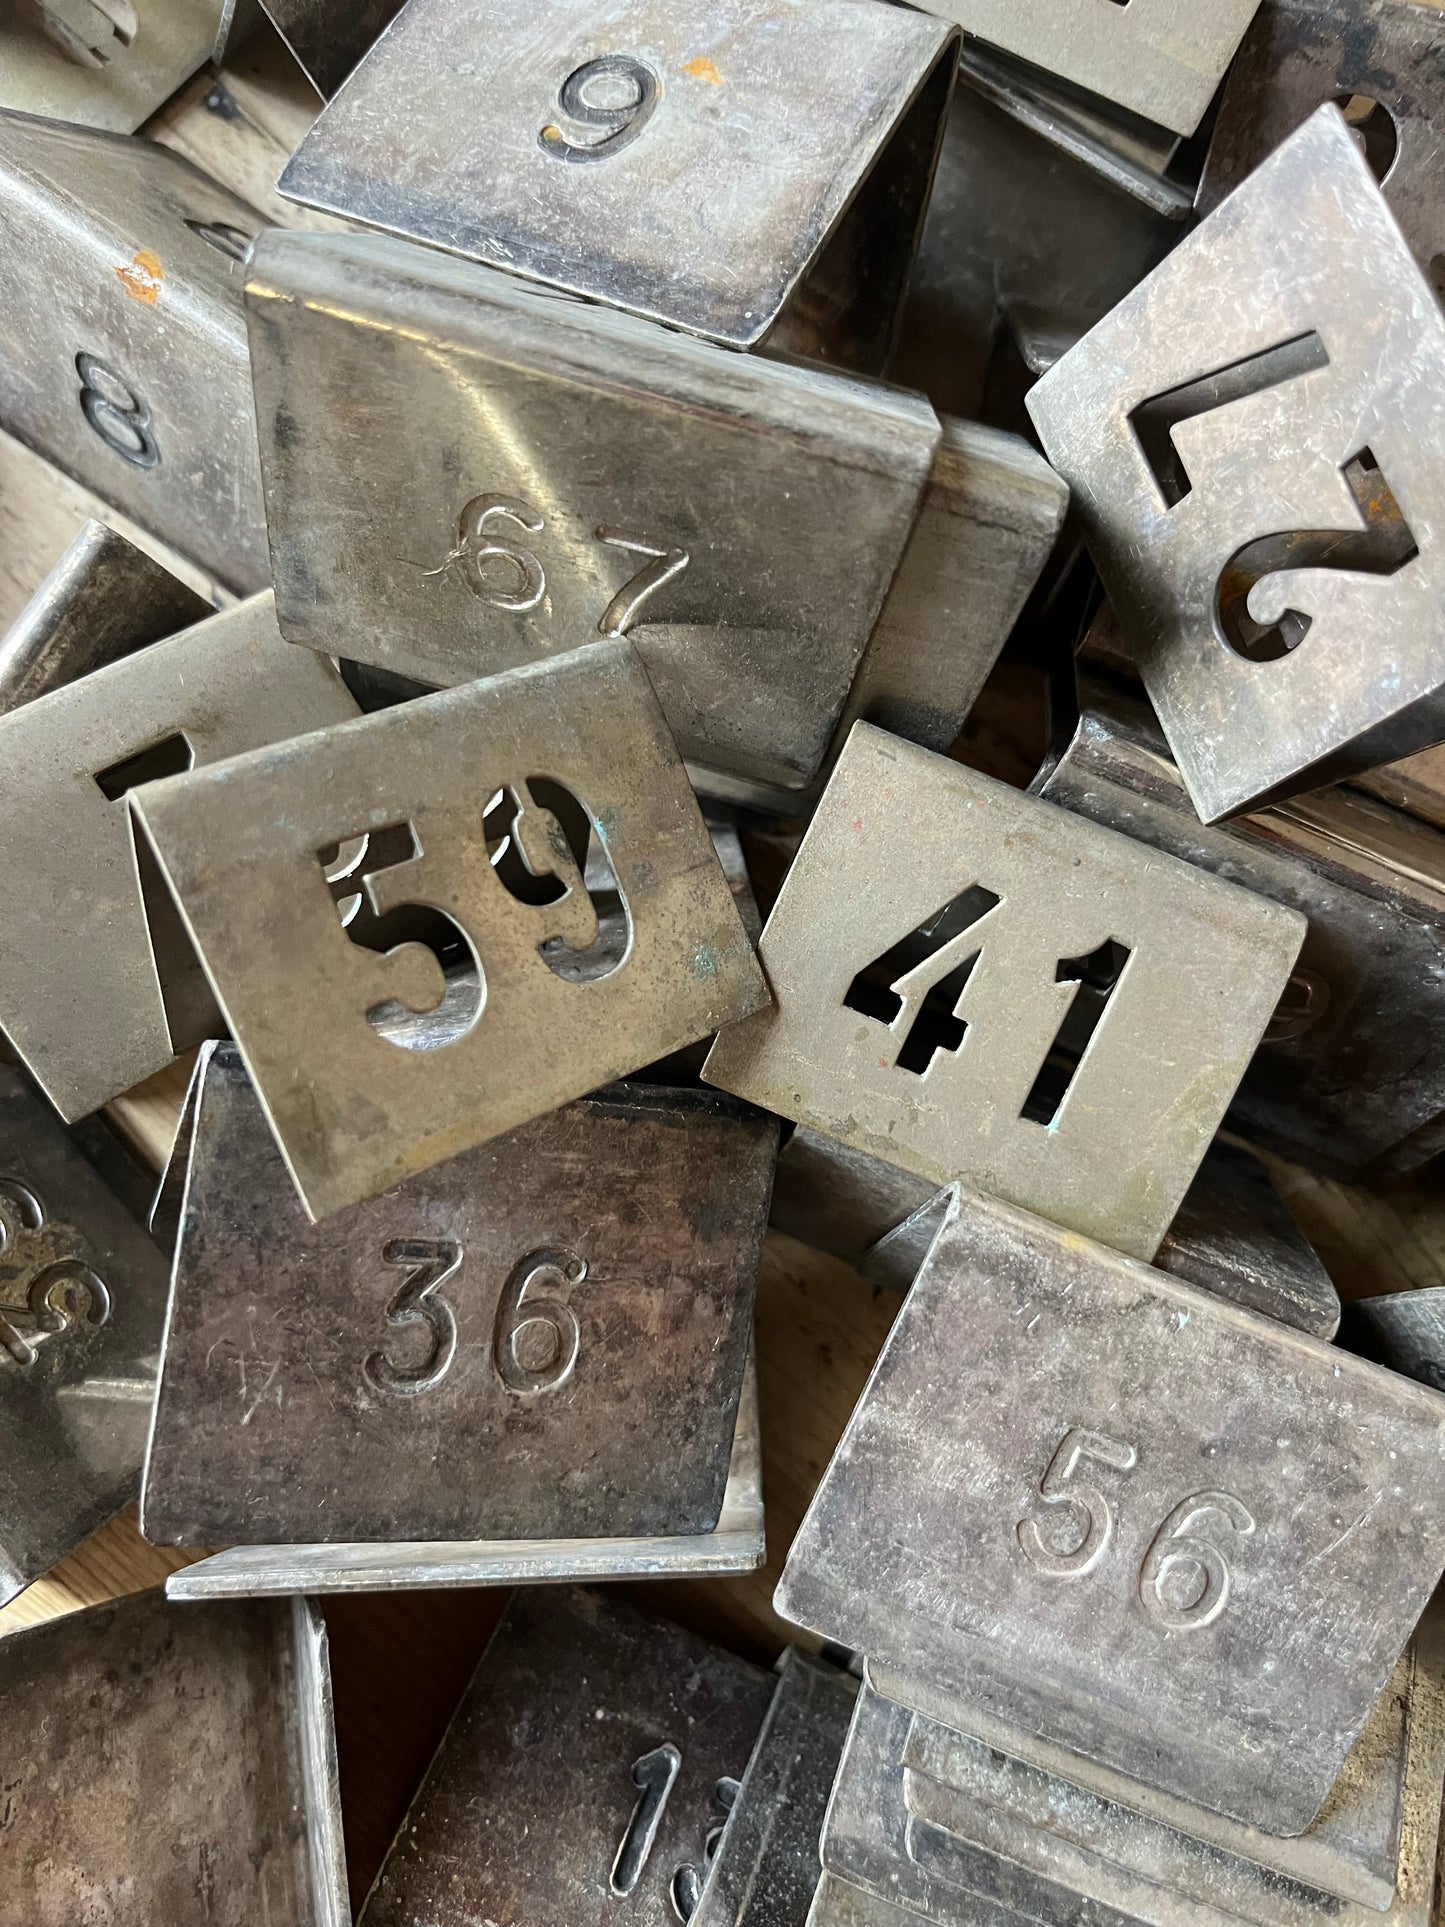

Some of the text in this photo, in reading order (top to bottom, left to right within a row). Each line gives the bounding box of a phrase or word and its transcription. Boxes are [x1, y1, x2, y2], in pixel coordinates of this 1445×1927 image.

[74, 350, 162, 470] 8
[455, 492, 691, 637] 67
[315, 774, 636, 1053] 59
[841, 883, 1138, 1132] 41
[362, 1237, 589, 1399] 36
[1015, 1427, 1257, 1632] 56
